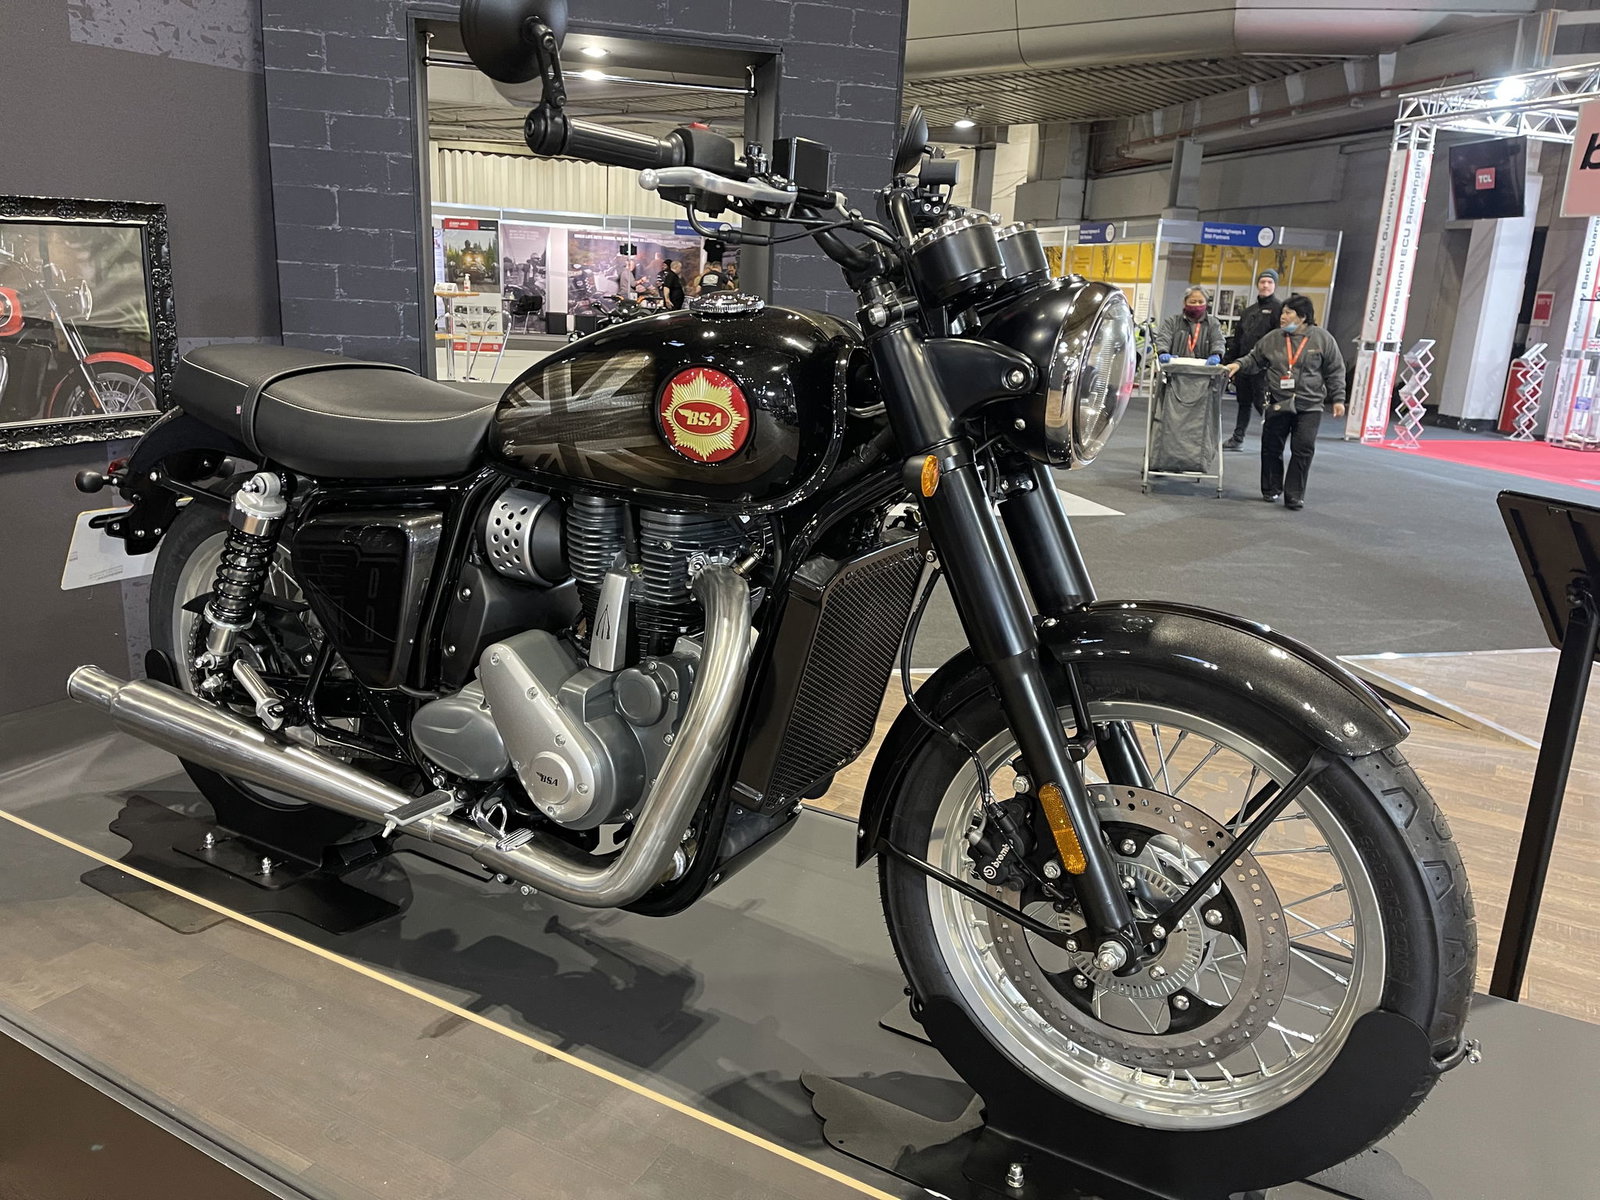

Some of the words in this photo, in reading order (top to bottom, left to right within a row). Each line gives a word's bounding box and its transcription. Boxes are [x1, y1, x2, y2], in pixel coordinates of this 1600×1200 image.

[1478, 174, 1492, 184] TCL
[1369, 279, 1382, 322] Money
[1376, 246, 1387, 276] Back
[1382, 171, 1398, 241] Guarantee
[1386, 260, 1405, 340] Professional
[1401, 228, 1411, 256] ECU
[1406, 151, 1425, 224] Remapping
[1581, 260, 1593, 290] Back
[677, 408, 722, 427] BSA
[536, 771, 559, 787] BSA
